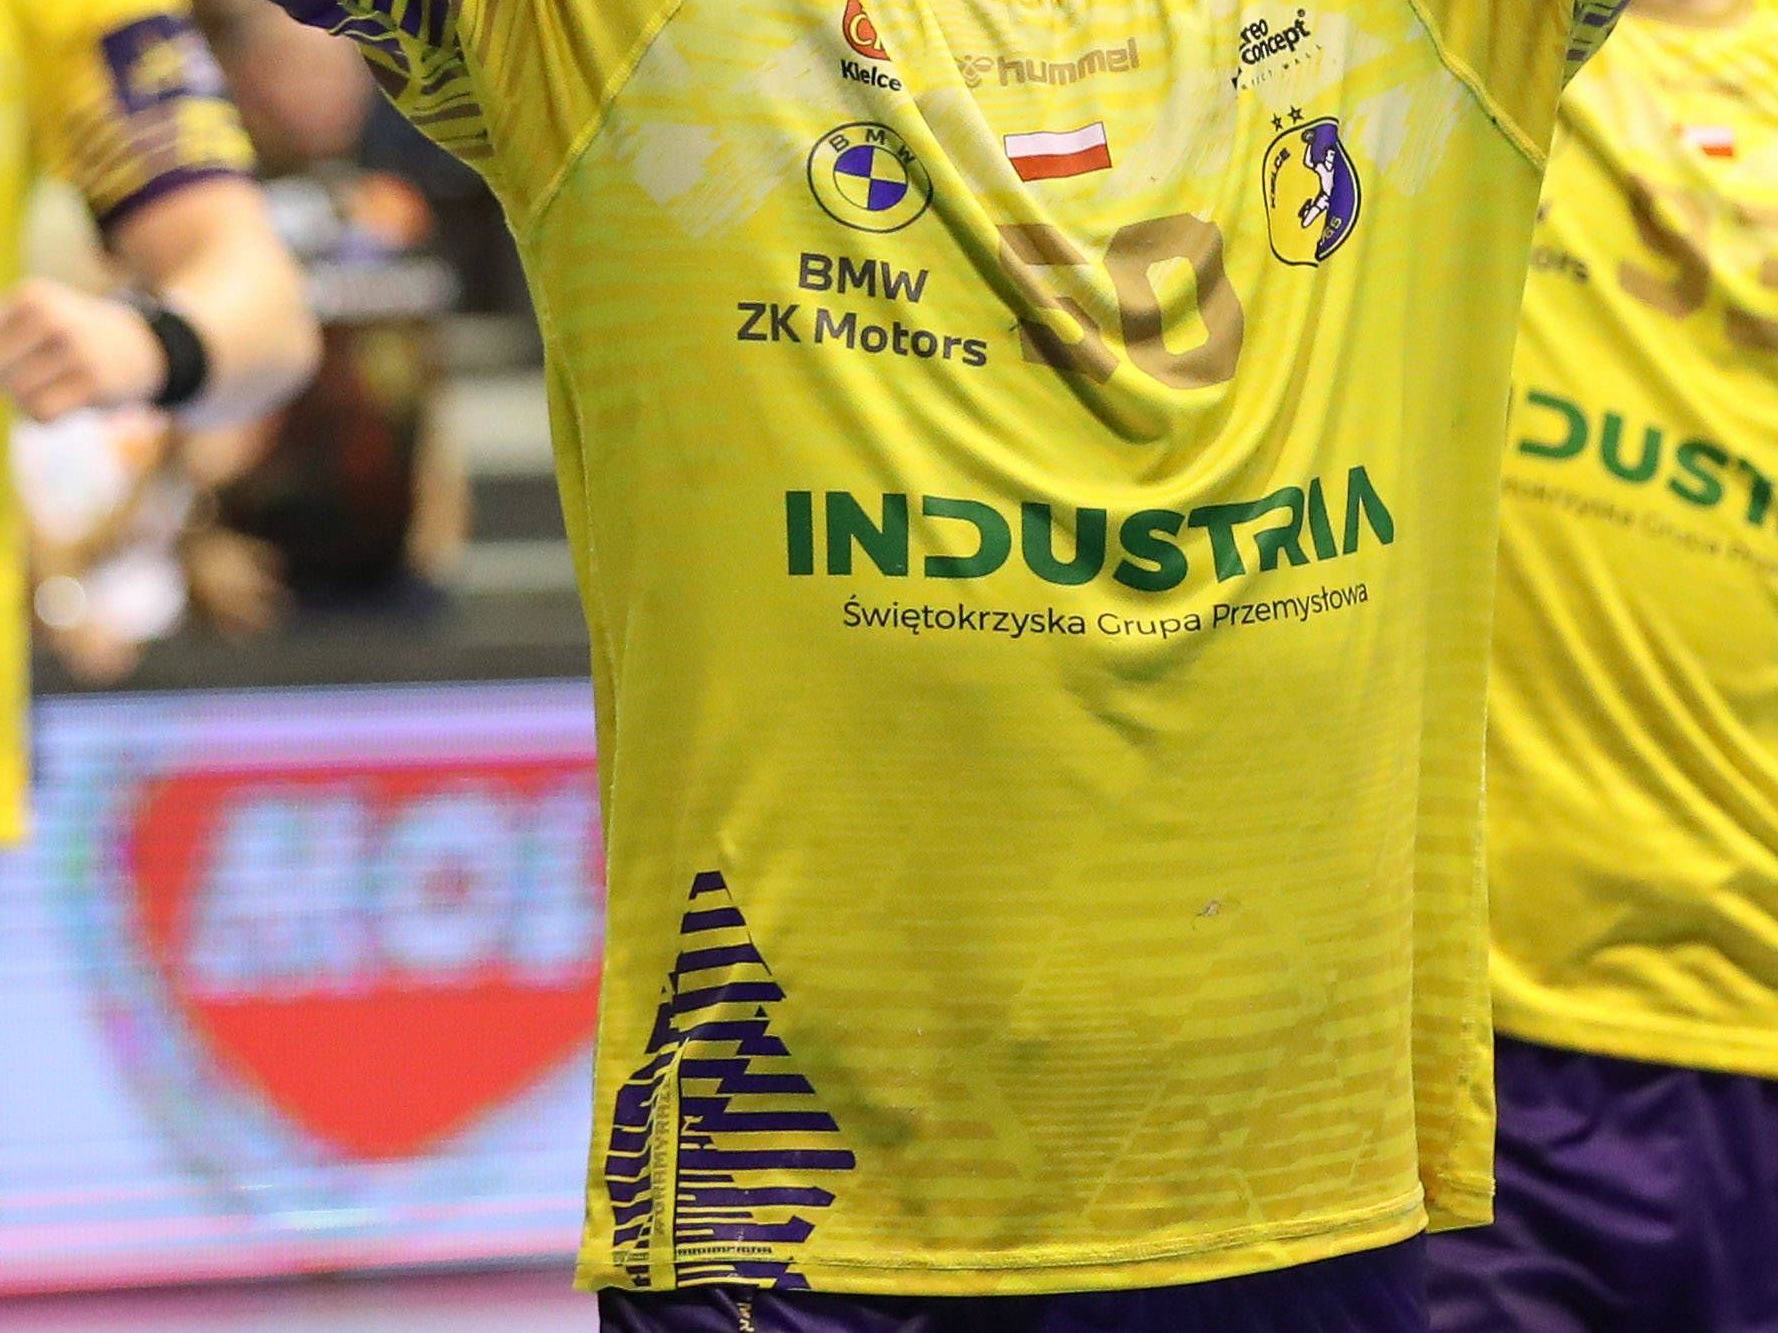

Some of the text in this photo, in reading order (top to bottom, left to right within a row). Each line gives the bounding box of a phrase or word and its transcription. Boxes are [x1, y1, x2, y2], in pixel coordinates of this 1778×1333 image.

[1000, 37, 1139, 87] hummel
[1238, 18, 1269, 51] reo
[841, 58, 902, 91] Kielce
[799, 252, 928, 303] BMW
[1000, 213, 1245, 390] 50
[737, 302, 988, 367] ZK Motors
[786, 465, 1395, 593] INDUSTRIA
[843, 580, 1370, 640] Świętokrzyska Grupa Przemysłowa
